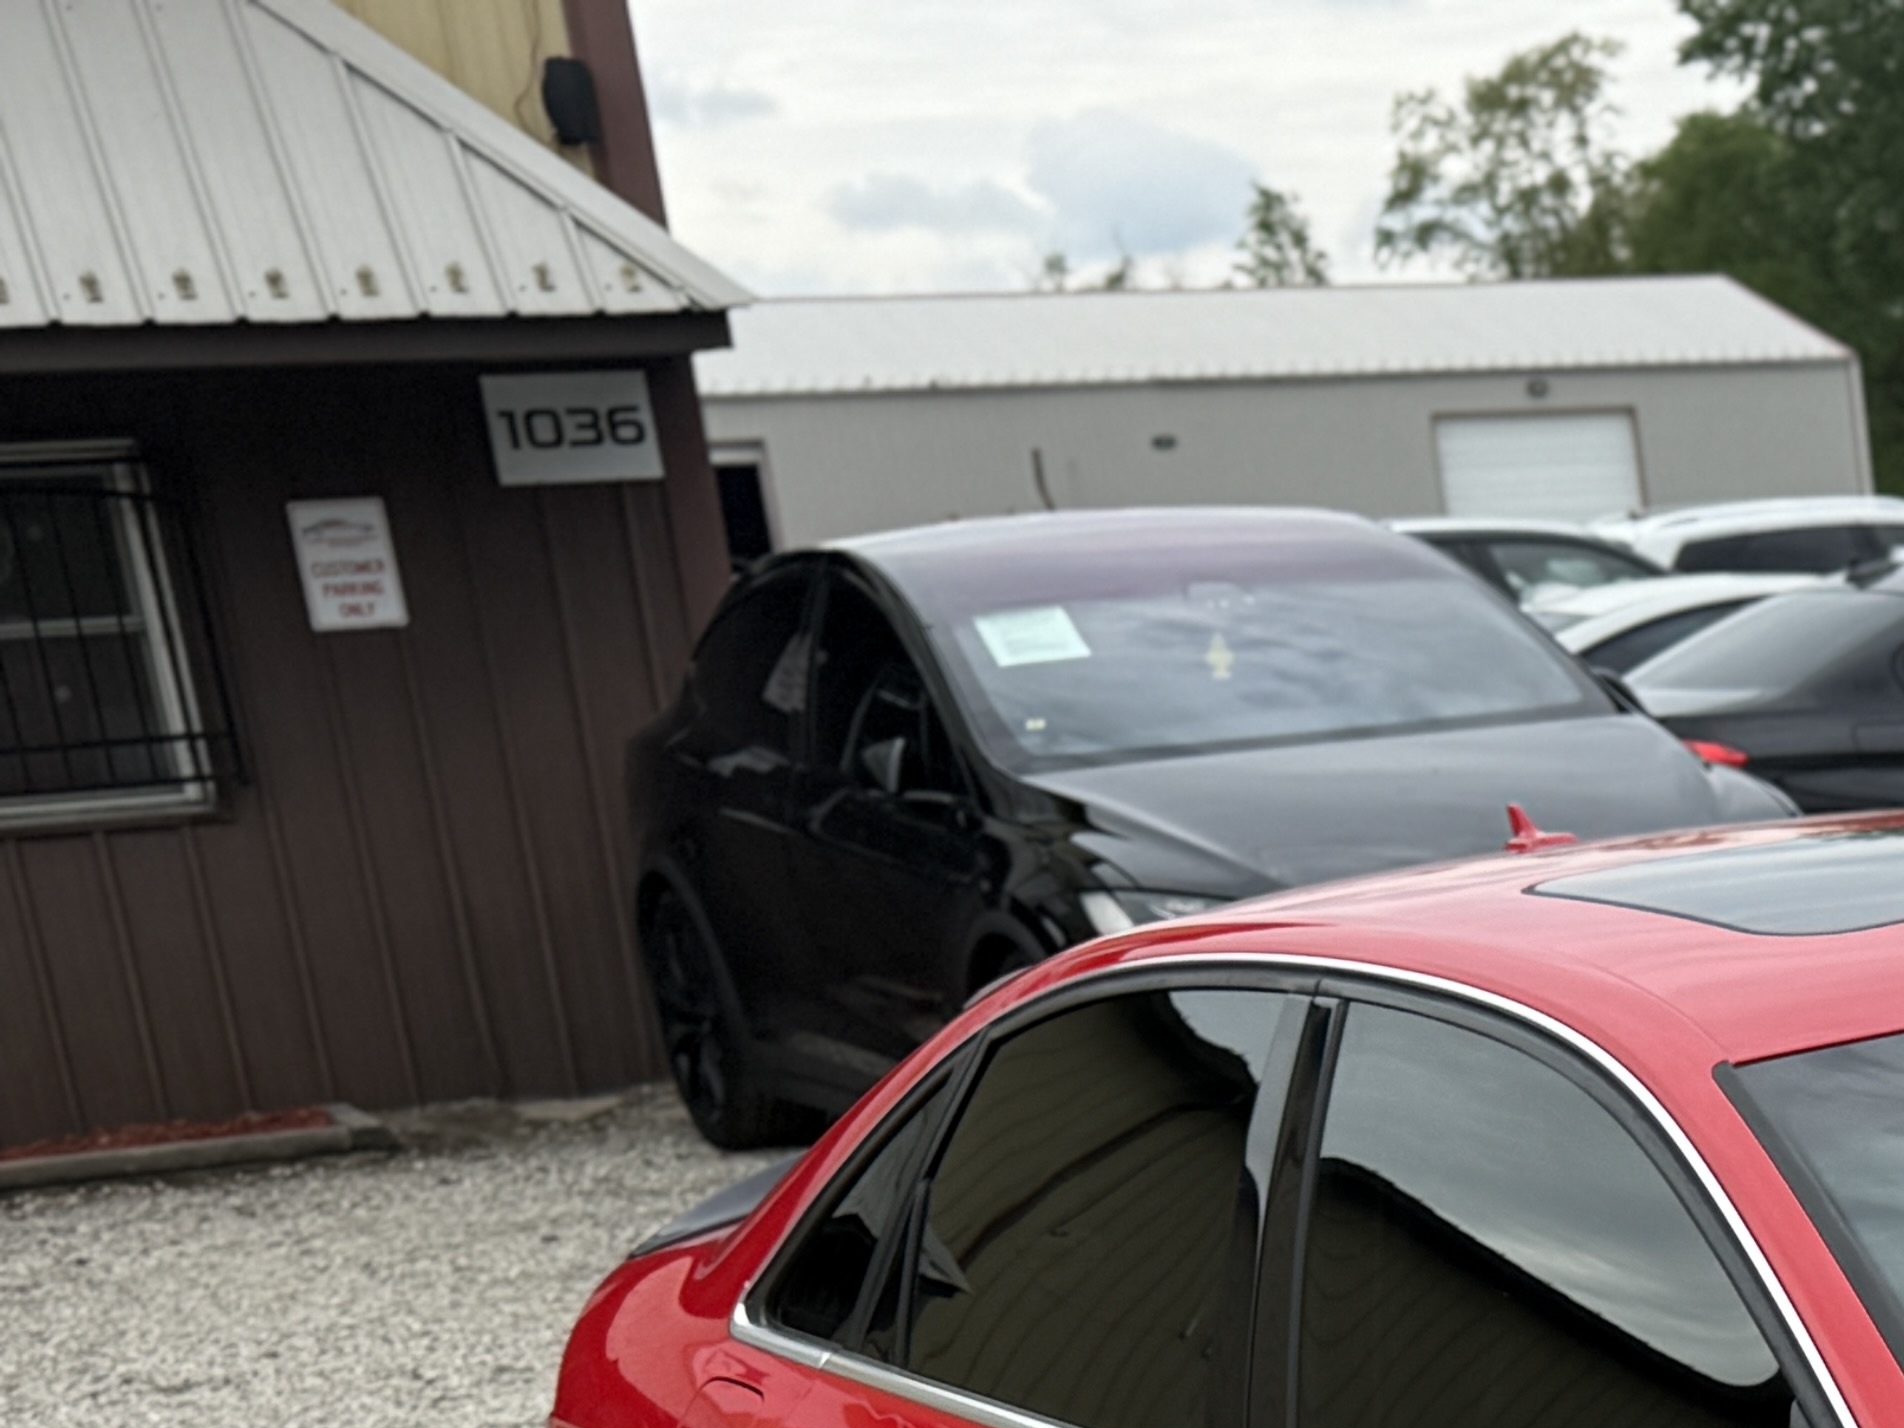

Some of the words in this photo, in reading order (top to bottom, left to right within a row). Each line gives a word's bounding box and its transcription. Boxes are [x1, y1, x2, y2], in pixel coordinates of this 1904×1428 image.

[498, 405, 645, 449] 1036
[311, 559, 385, 578] CUSTOMER
[322, 580, 384, 599] PARKING
[338, 601, 375, 618] ONLY
